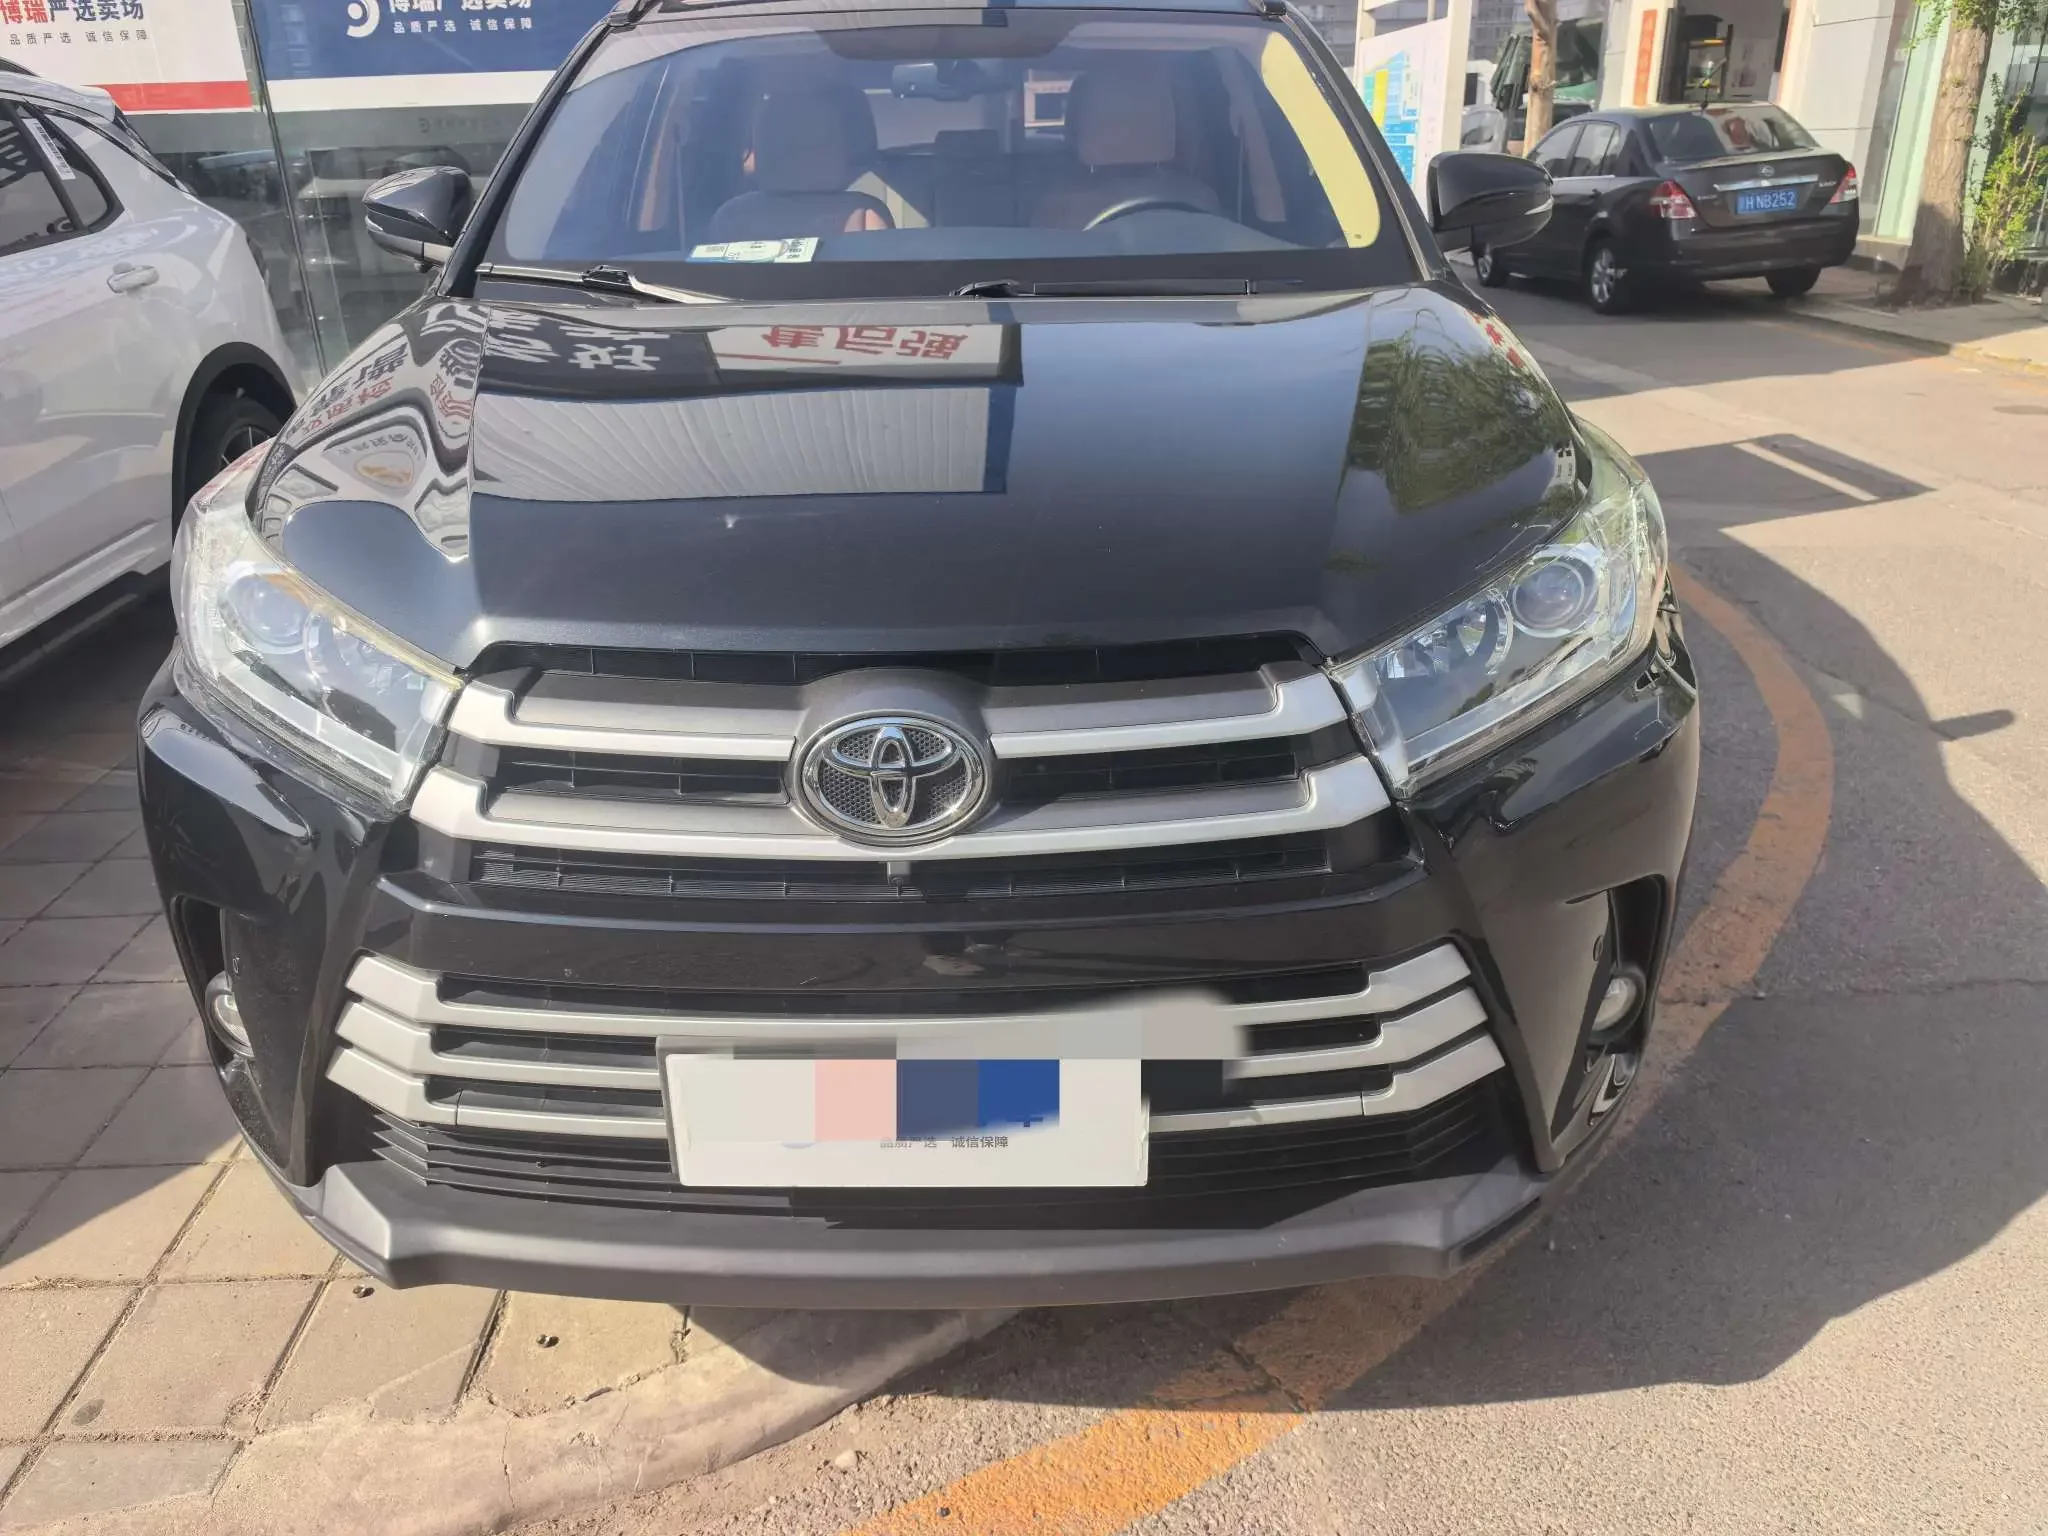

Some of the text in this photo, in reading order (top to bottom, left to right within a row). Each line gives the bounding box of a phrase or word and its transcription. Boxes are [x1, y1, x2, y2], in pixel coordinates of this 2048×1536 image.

[393, 19, 456, 34] 品质严选
[10, 29, 147, 46] 品质严选 诚信保障
[950, 1135, 1009, 1149] 诚信保障
